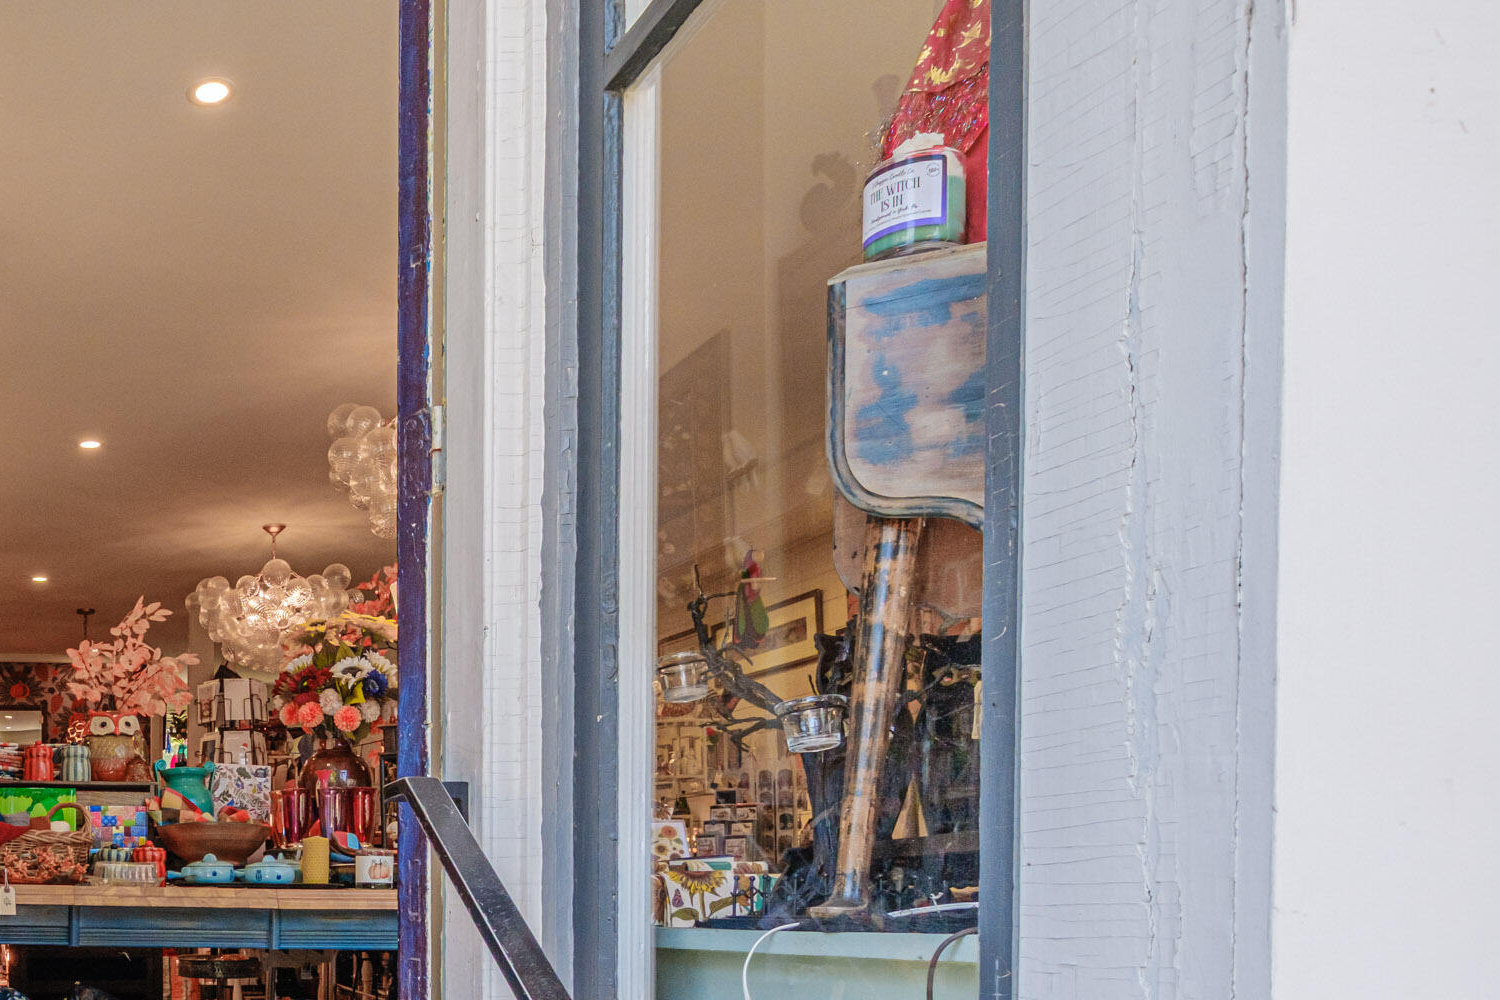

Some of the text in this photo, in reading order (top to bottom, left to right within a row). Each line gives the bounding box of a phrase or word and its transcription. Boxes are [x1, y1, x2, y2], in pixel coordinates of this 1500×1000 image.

[871, 187, 884, 206] THE
[886, 176, 921, 196] WITCH
[880, 193, 903, 213] IS IN
